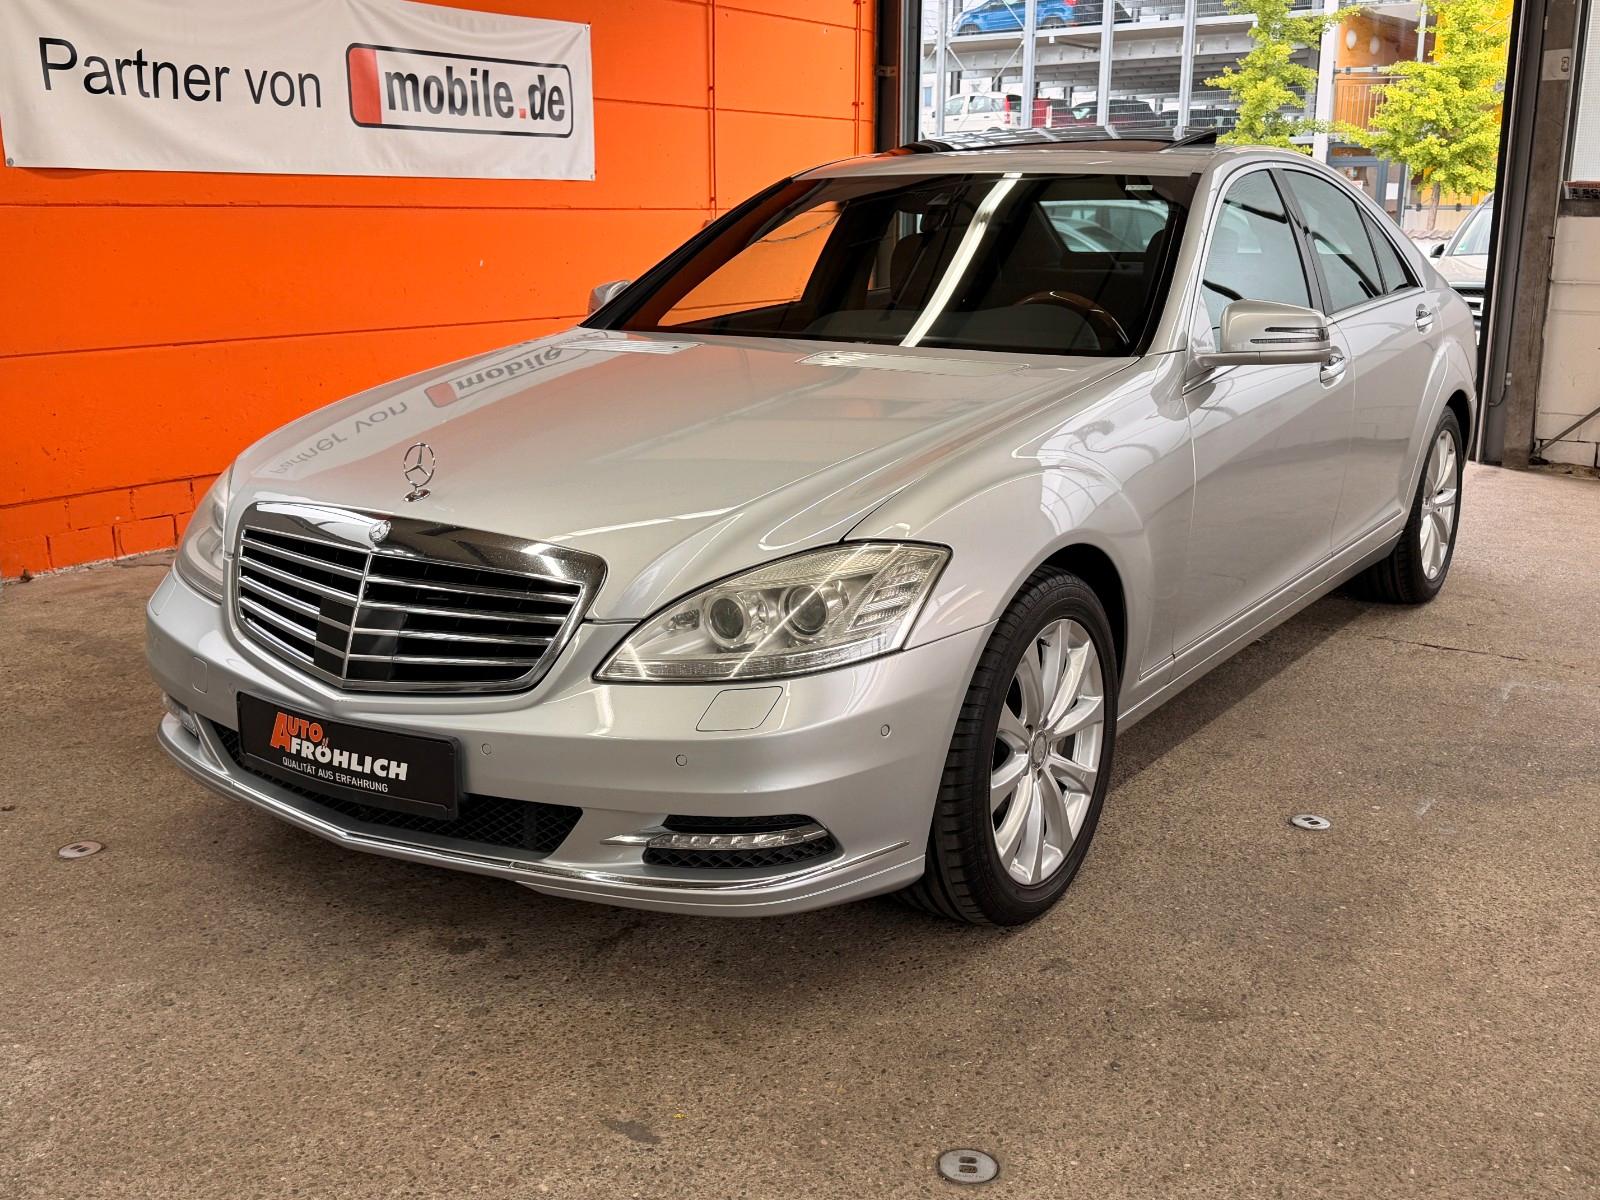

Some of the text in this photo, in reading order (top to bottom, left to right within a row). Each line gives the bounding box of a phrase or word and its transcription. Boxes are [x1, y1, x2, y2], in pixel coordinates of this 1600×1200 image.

[38, 36, 566, 122] Partner von mobile.de
[270, 711, 323, 752] AUTO
[282, 756, 388, 792] QUALITÄT AUS ERFAHRUNG
[290, 737, 408, 780] FRÖHLICH
